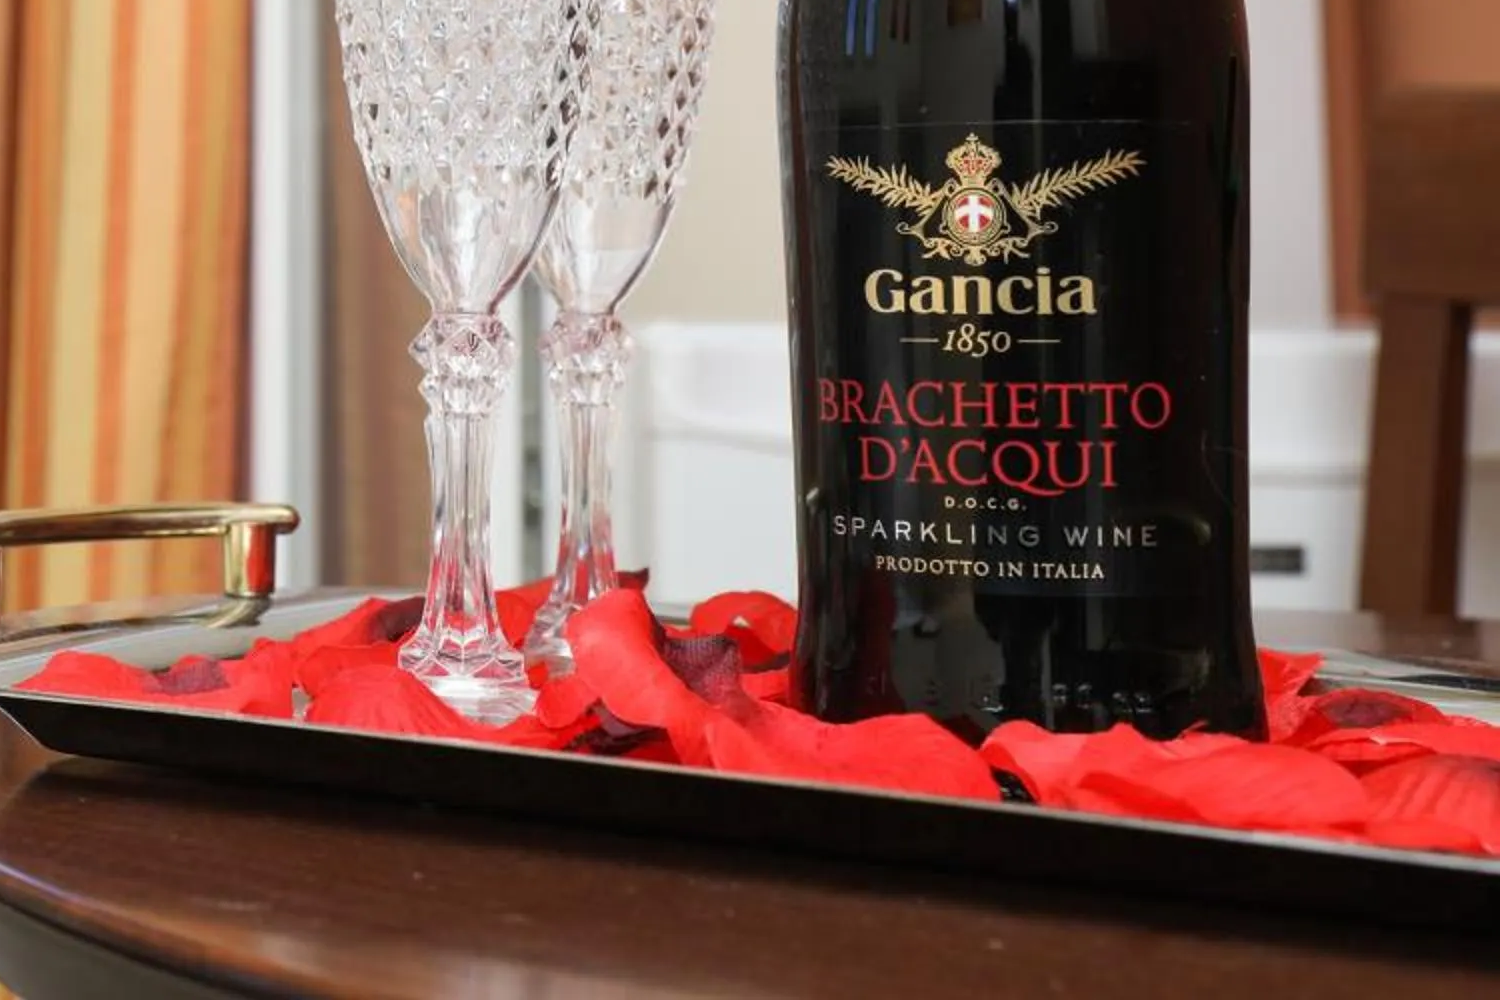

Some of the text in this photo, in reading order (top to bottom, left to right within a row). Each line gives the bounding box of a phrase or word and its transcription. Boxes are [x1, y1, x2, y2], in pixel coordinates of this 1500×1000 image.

[864, 267, 1098, 316] Gancia
[942, 323, 1012, 358] 1850
[818, 377, 1173, 430] BRACHETTO
[858, 436, 1120, 497] D'ACQUI
[944, 496, 1028, 512] D.O.C.G.
[833, 514, 1158, 548] SPARKLING WINE
[875, 555, 1106, 580] PRODOTTO IN ITALIA
